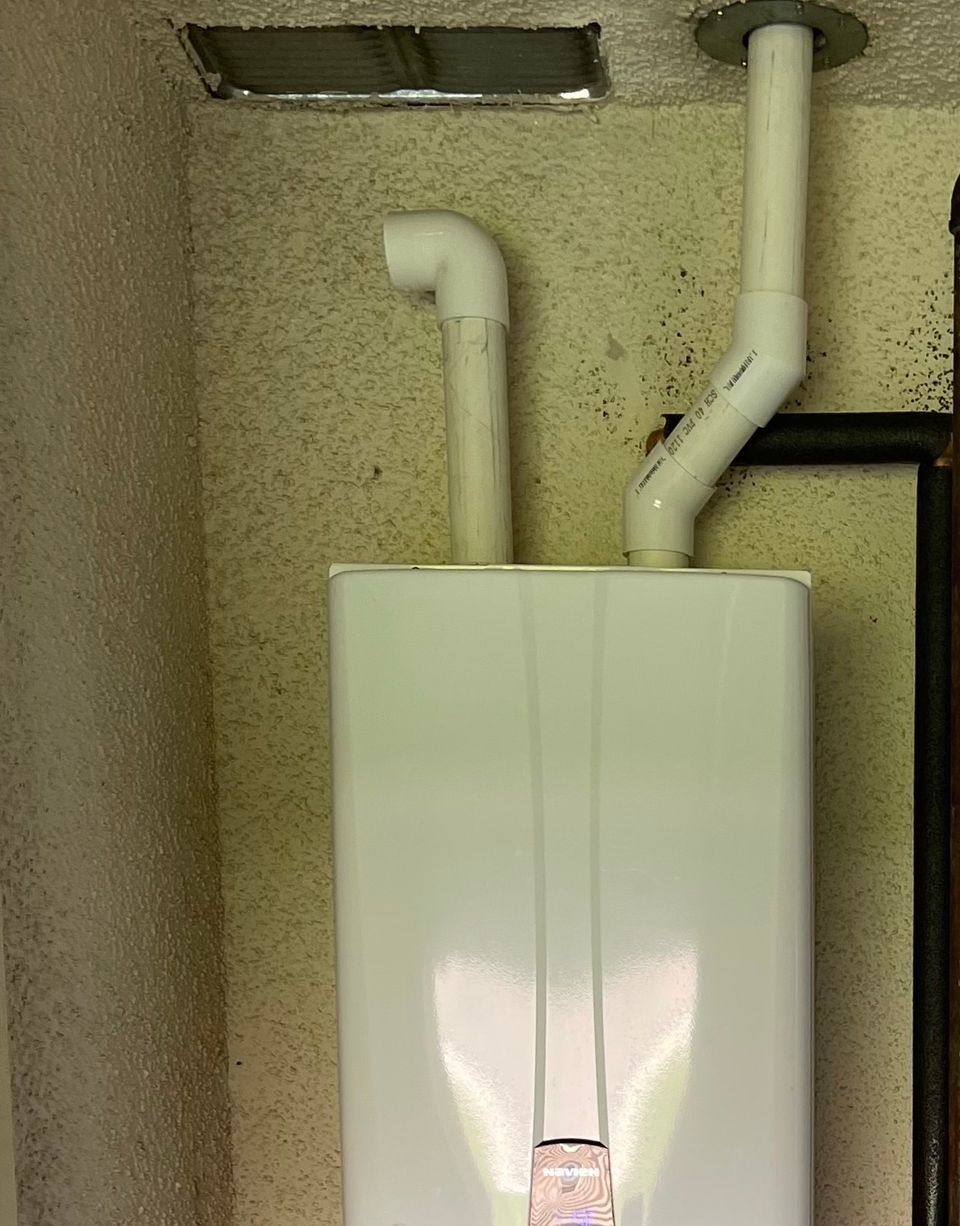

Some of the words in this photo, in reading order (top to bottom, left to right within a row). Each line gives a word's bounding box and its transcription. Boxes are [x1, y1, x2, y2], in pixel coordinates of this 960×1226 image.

[705, 389, 718, 407] SCH
[695, 408, 705, 420] 40
[683, 418, 696, 435] PVC
[668, 434, 684, 456] 1120
